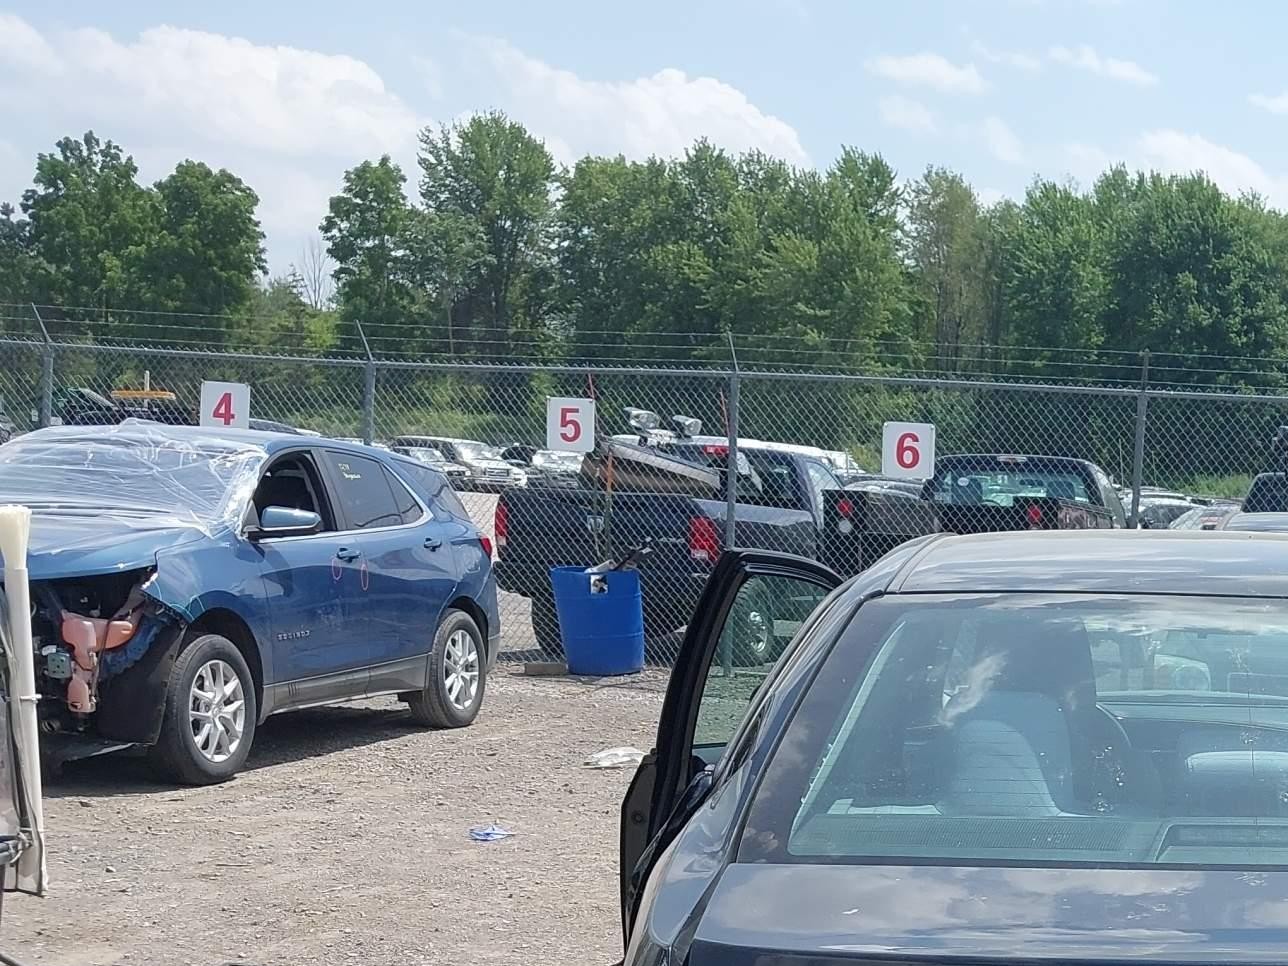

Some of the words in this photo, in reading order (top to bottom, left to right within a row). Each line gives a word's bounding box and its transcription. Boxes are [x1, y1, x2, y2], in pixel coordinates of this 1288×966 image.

[212, 392, 236, 426] 4
[560, 407, 581, 443] 5
[896, 432, 920, 469] 6
